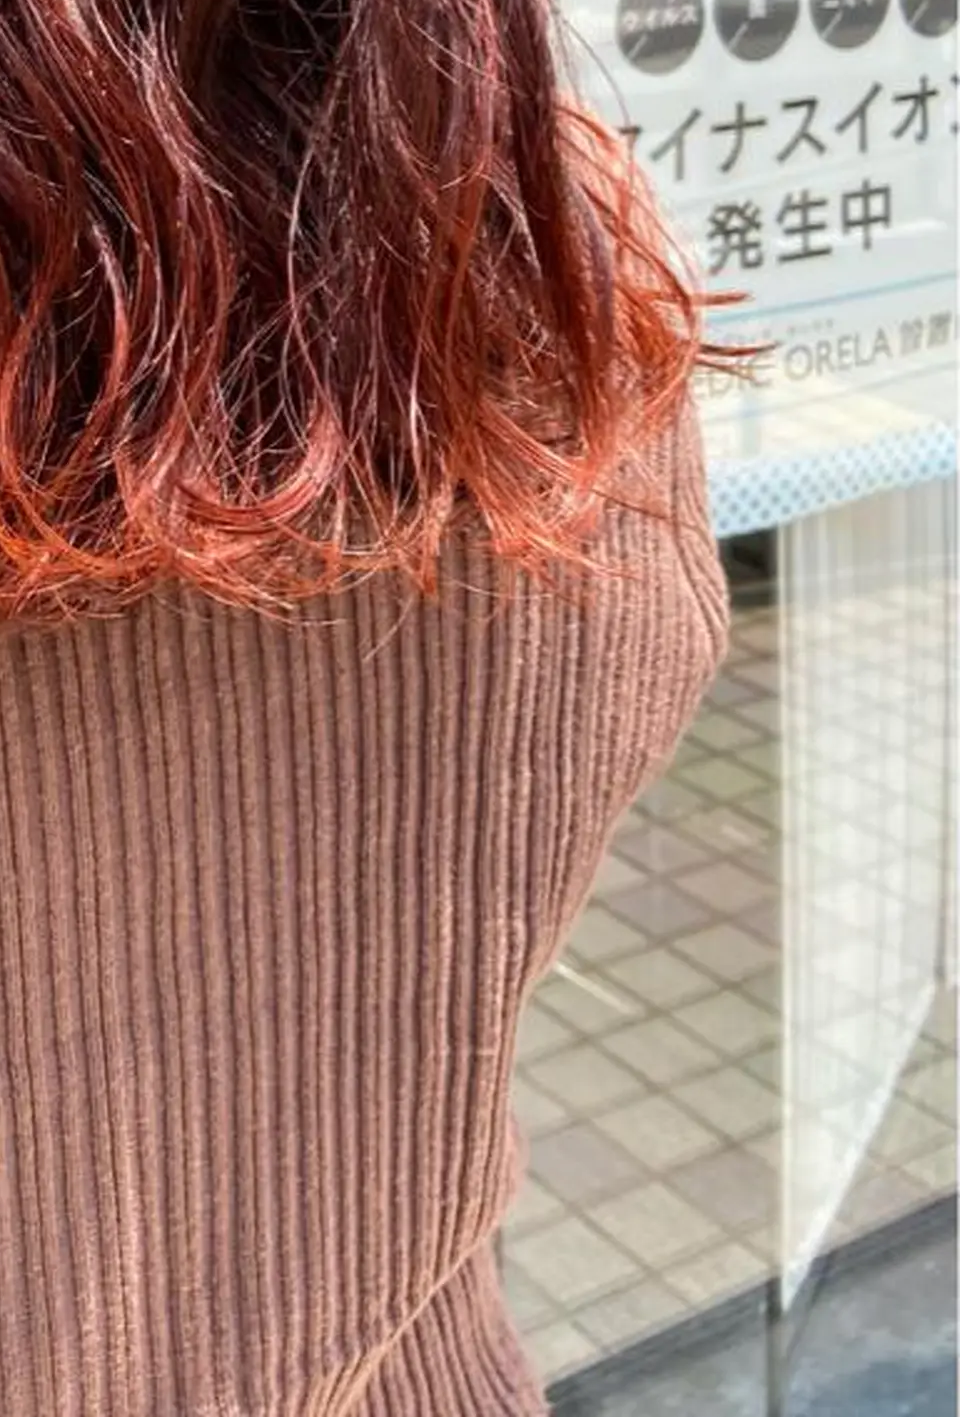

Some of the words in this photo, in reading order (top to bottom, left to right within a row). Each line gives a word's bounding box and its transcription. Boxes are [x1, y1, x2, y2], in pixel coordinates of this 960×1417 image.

[708, 178, 892, 276] 発生中
[784, 326, 893, 381] ORELA
